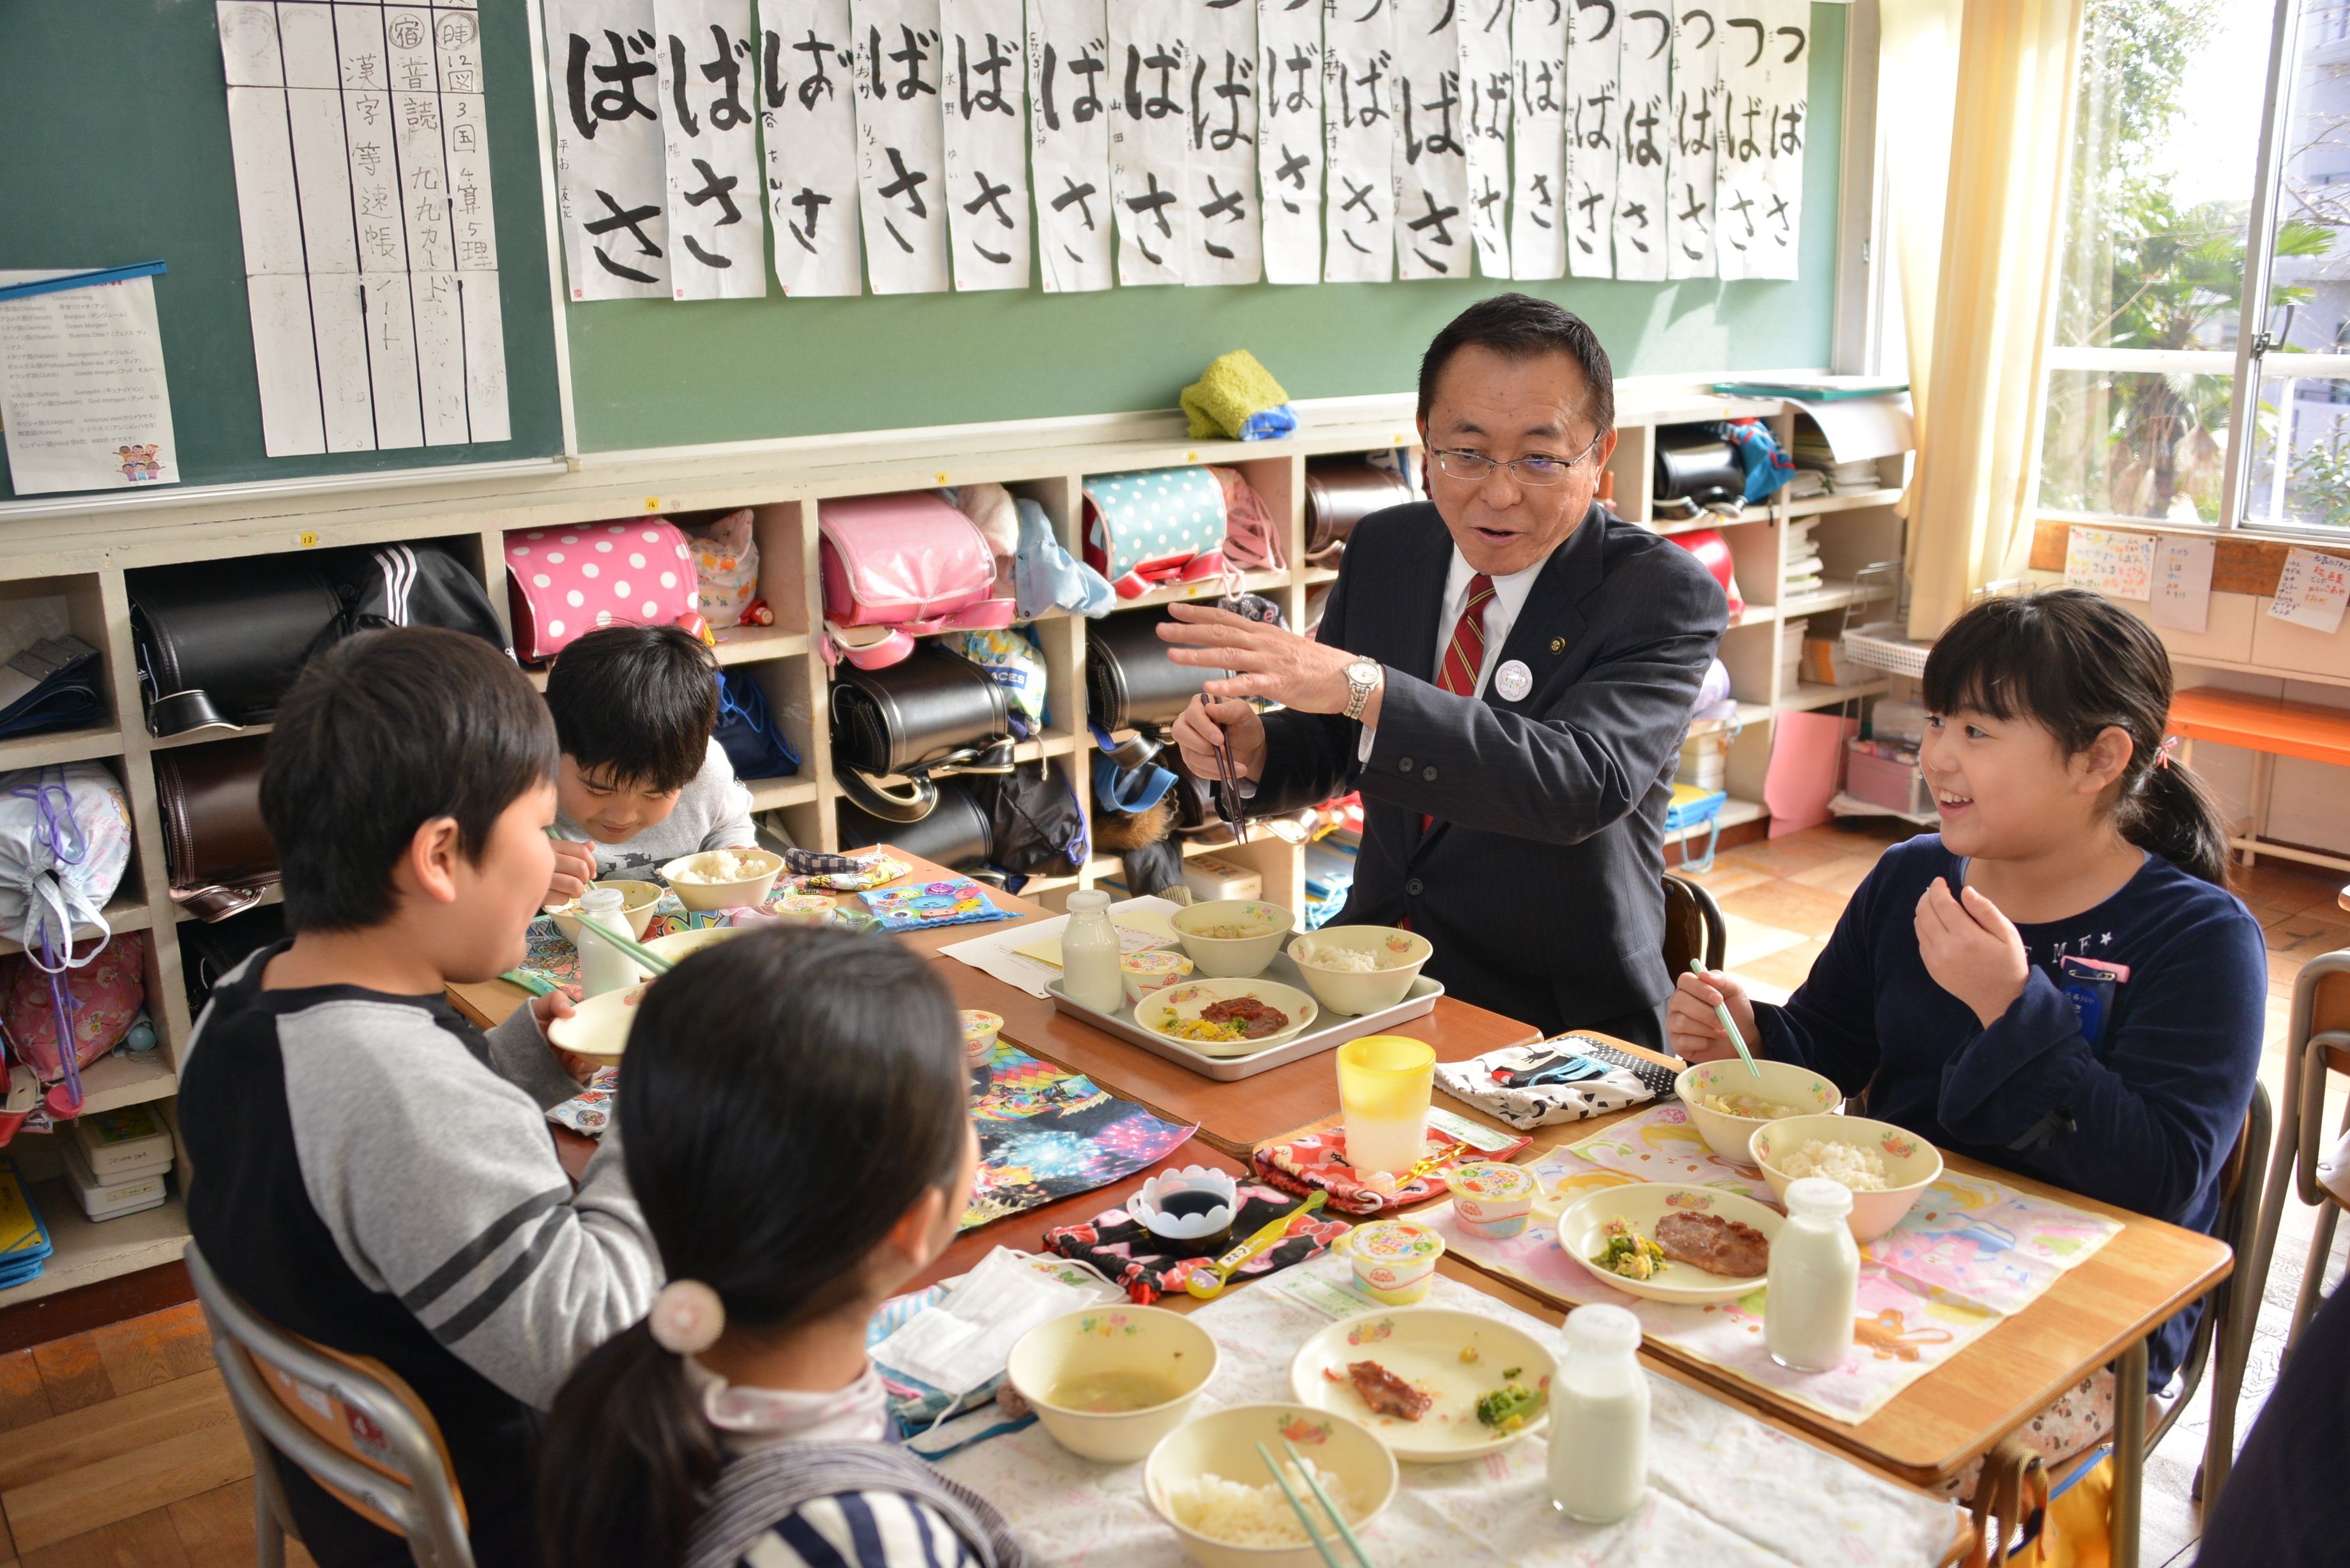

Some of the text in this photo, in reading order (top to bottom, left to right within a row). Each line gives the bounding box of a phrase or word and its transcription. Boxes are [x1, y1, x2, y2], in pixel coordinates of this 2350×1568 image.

[567, 29, 663, 283] ばさ
[669, 24, 753, 269] ばさ
[764, 29, 854, 255] ばさ
[869, 23, 939, 253] ばさ
[956, 33, 1019, 264] ばさ
[1042, 38, 1105, 263] ばさ
[1124, 39, 1184, 265] ばさ
[1192, 0, 1253, 259] ばさ
[1267, 0, 1317, 214] ばさ
[1341, 0, 1391, 253] ばさ
[1402, 0, 1465, 274] ばさ
[1623, 9, 1668, 253] つばさ
[1678, 9, 1719, 260] つばさ
[1725, 18, 1764, 250] つばさ
[1765, 26, 1807, 246] つばさ
[991, 671, 1025, 685] ACES
